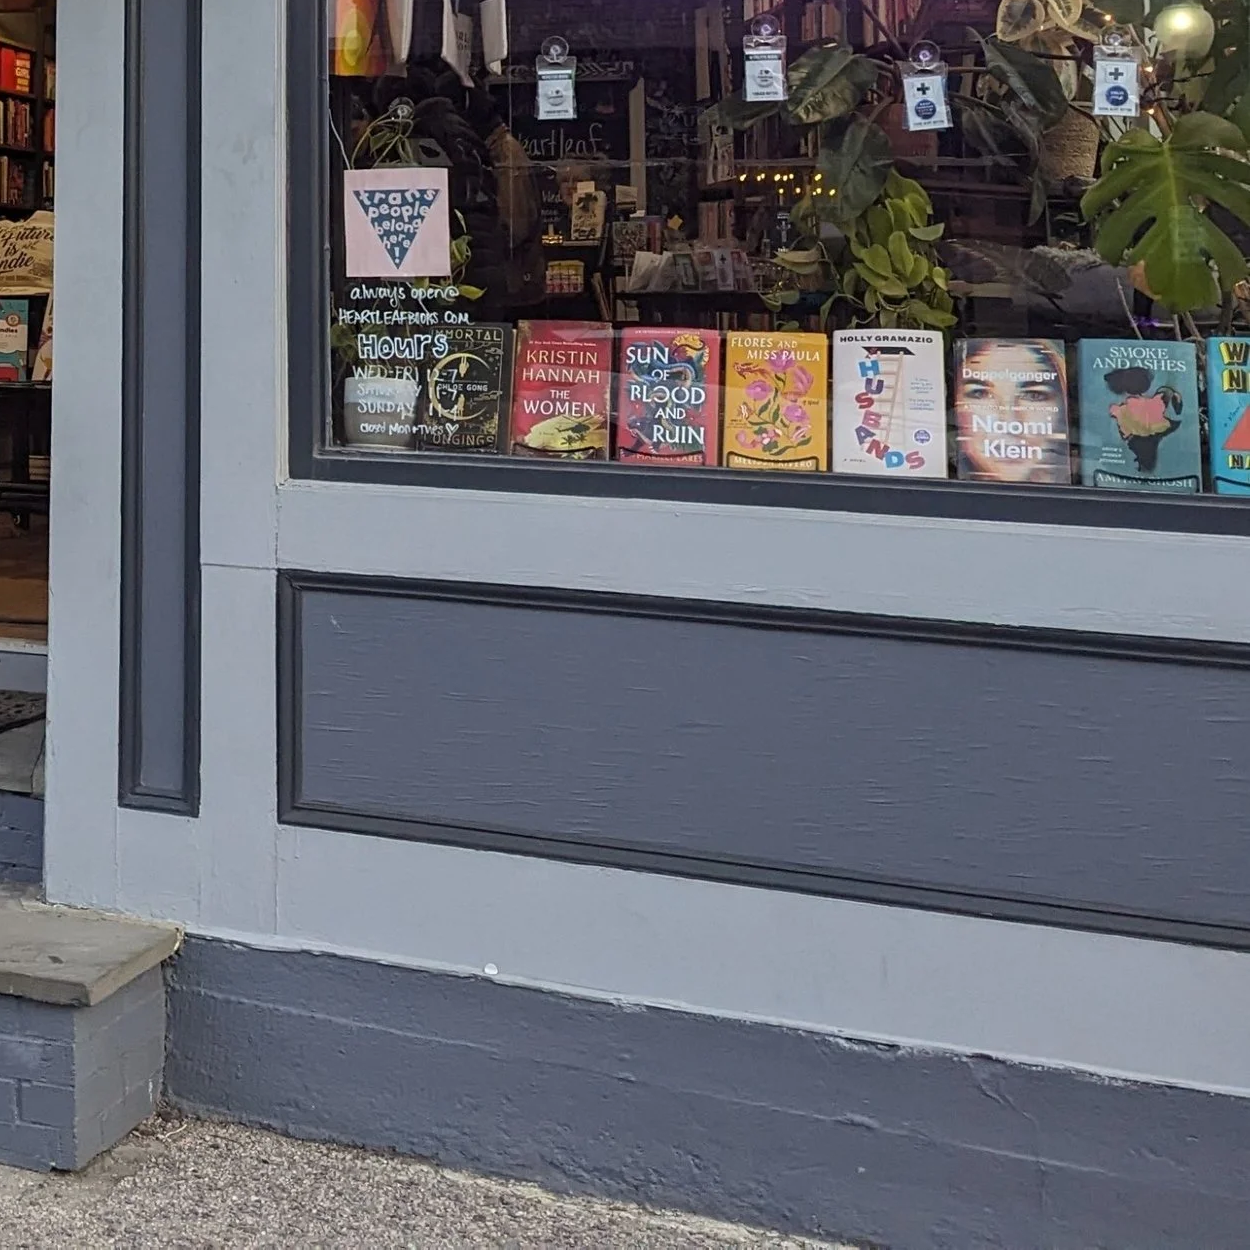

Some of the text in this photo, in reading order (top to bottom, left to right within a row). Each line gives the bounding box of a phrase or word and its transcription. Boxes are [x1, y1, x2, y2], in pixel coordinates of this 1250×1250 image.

[358, 188, 437, 206] trans
[367, 200, 431, 223] people
[374, 217, 423, 236] belong
[3, 242, 18, 258] is
[382, 233, 411, 250] here
[350, 284, 407, 308] always
[356, 333, 449, 361] Hours
[730, 337, 798, 349] FLORES AND
[839, 335, 934, 344] HOLLY GRAMAZIO
[526, 350, 598, 366] KRISTIN
[625, 346, 669, 365] SUN
[746, 349, 821, 362] MISS PAULA
[1109, 346, 1169, 360] SMOKE
[352, 364, 420, 382] WED-FRI
[1092, 357, 1187, 373] AND ASHES
[522, 367, 601, 385] HANNAH
[651, 369, 671, 382] OF
[962, 368, 1058, 382] Doppelganger
[437, 383, 489, 393] CHLOE GONG
[549, 389, 571, 400] THE
[630, 384, 706, 406] BLOOD
[523, 400, 596, 417] WOMEN
[654, 407, 686, 420] AND
[972, 414, 1053, 436] Naomi
[653, 424, 705, 446] RUIN
[983, 438, 1043, 460] Klein
